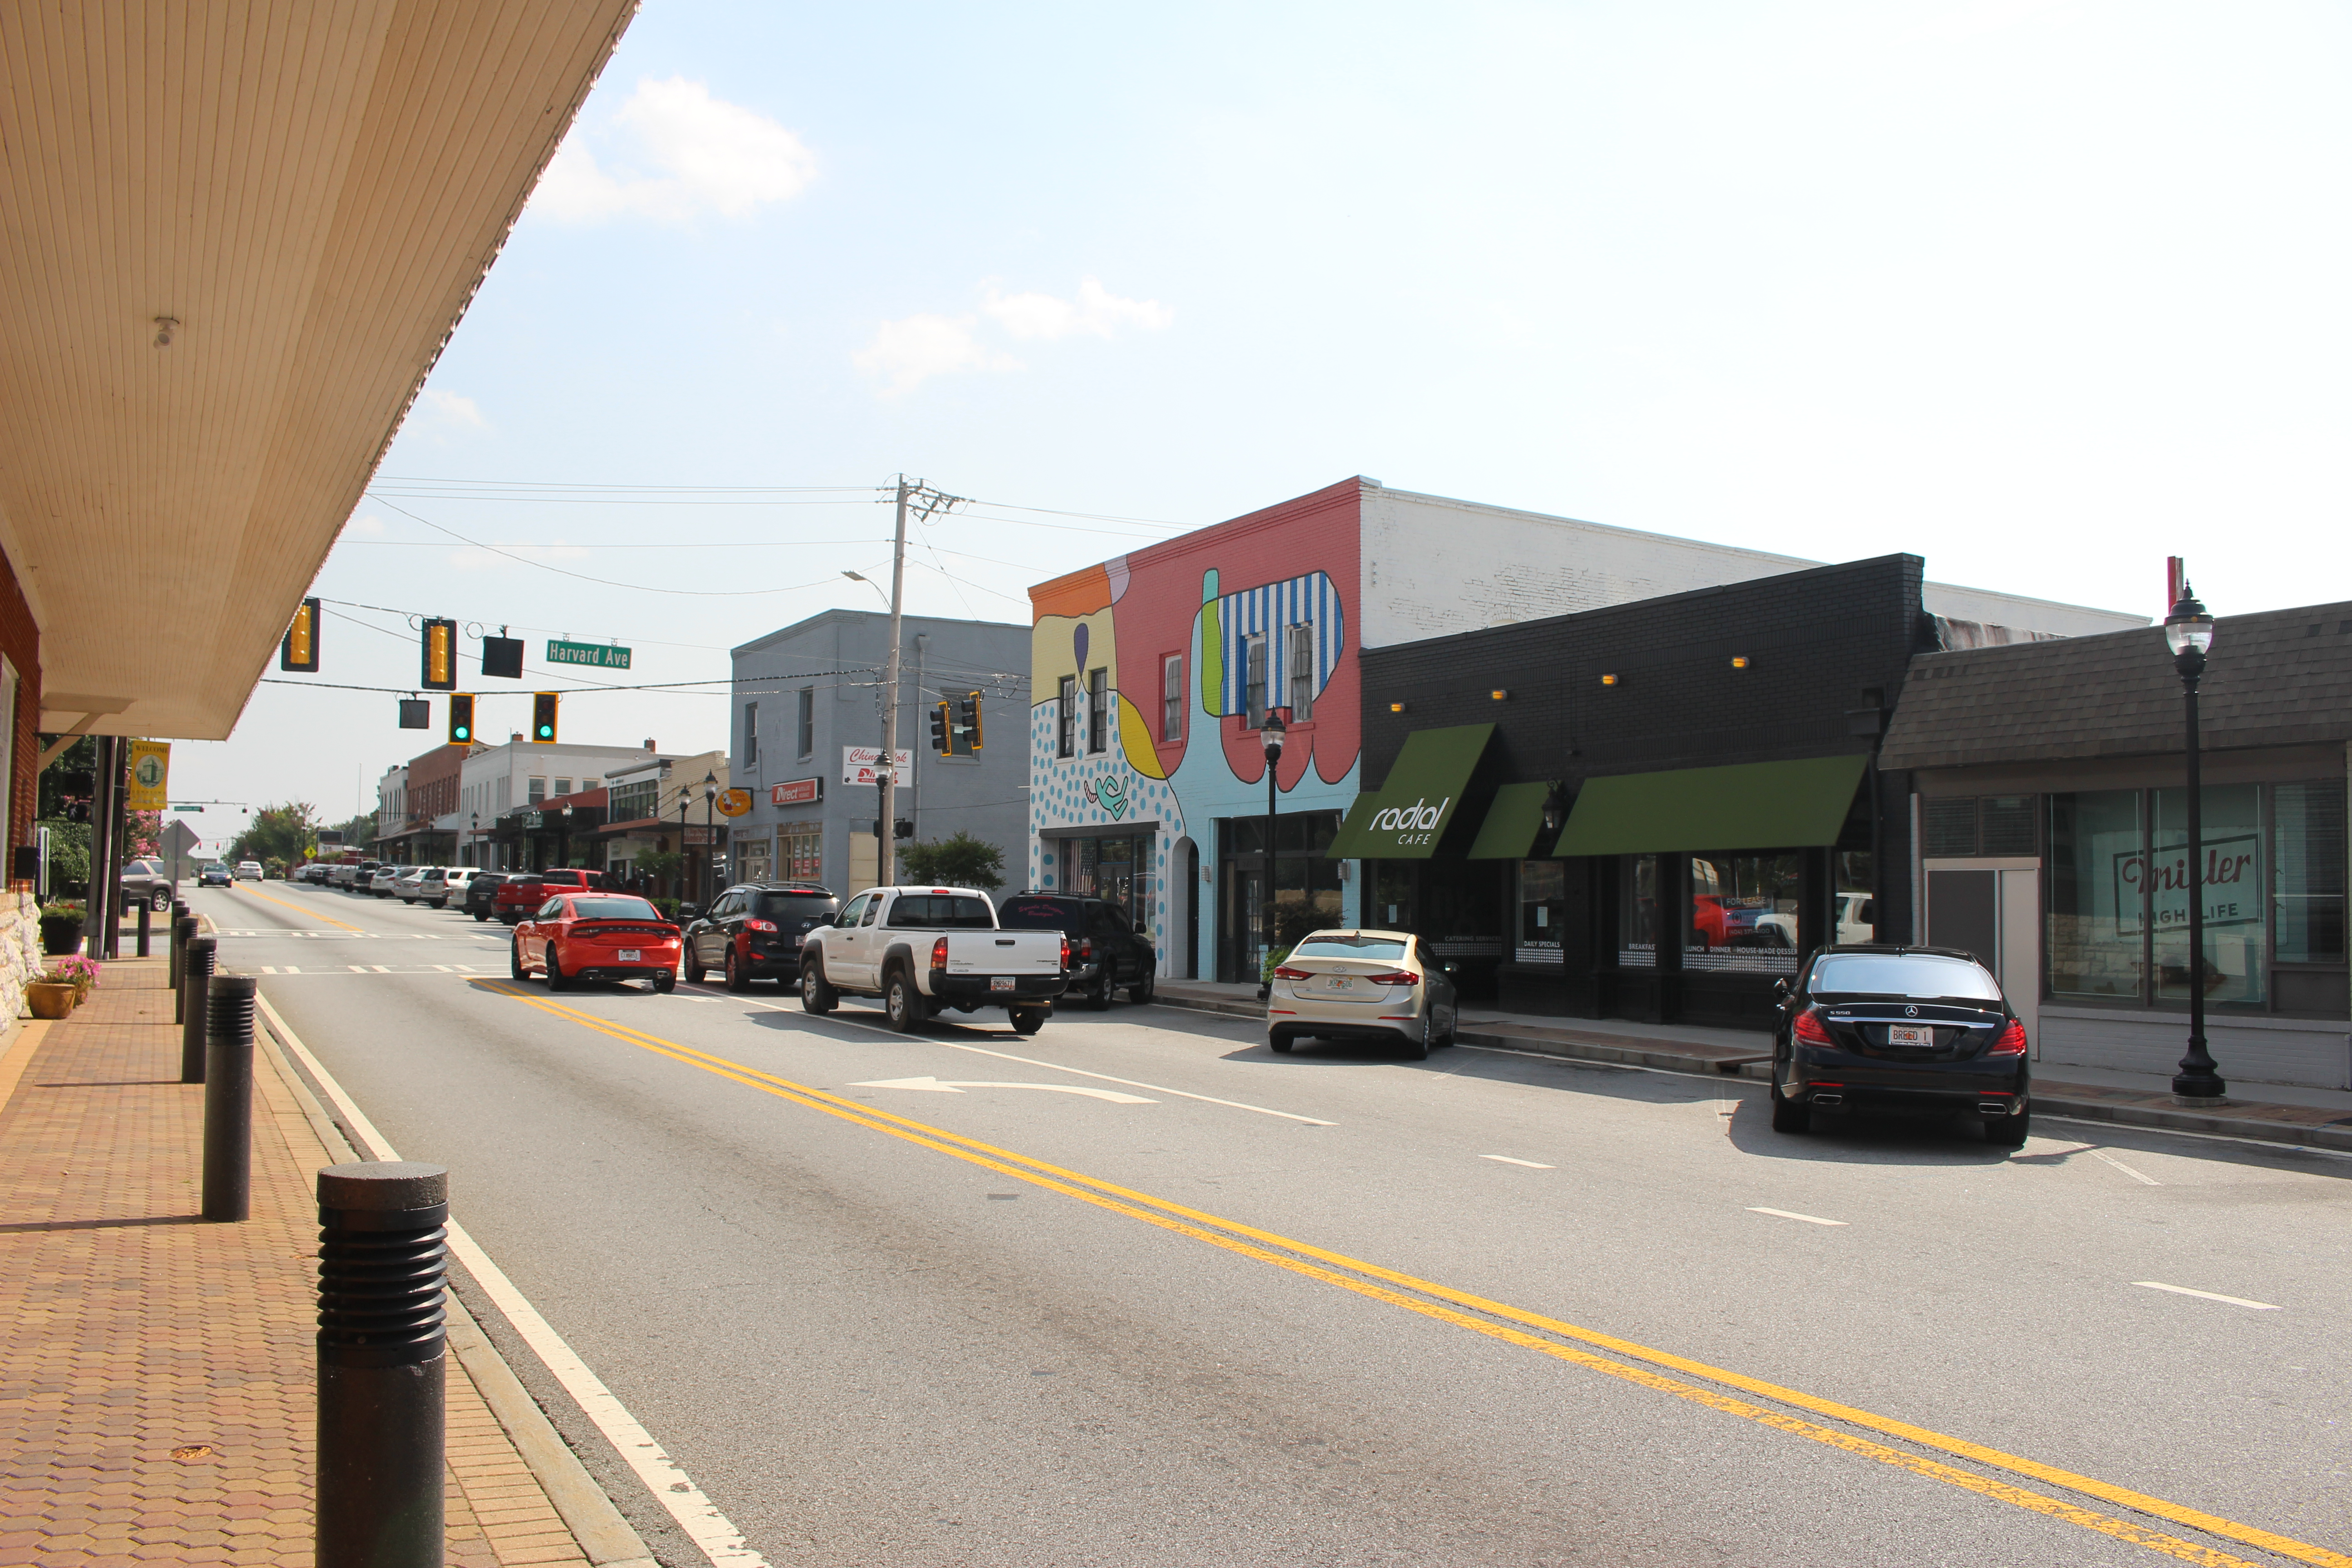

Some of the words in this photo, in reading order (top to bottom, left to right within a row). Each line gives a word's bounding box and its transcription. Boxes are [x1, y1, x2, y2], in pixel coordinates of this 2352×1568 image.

[549, 643, 599, 663] Harvard
[605, 649, 627, 666] Ave
[776, 786, 798, 801] Direct
[1368, 797, 1450, 831] radial
[1397, 833, 1431, 845] CAFE
[2122, 849, 2251, 894] Miler
[1743, 897, 1766, 905] LEASE
[1736, 946, 1776, 955] HOUSE-MADE
[1893, 1030, 1918, 1040] BREED
[1923, 1031, 1926, 1041] 1
